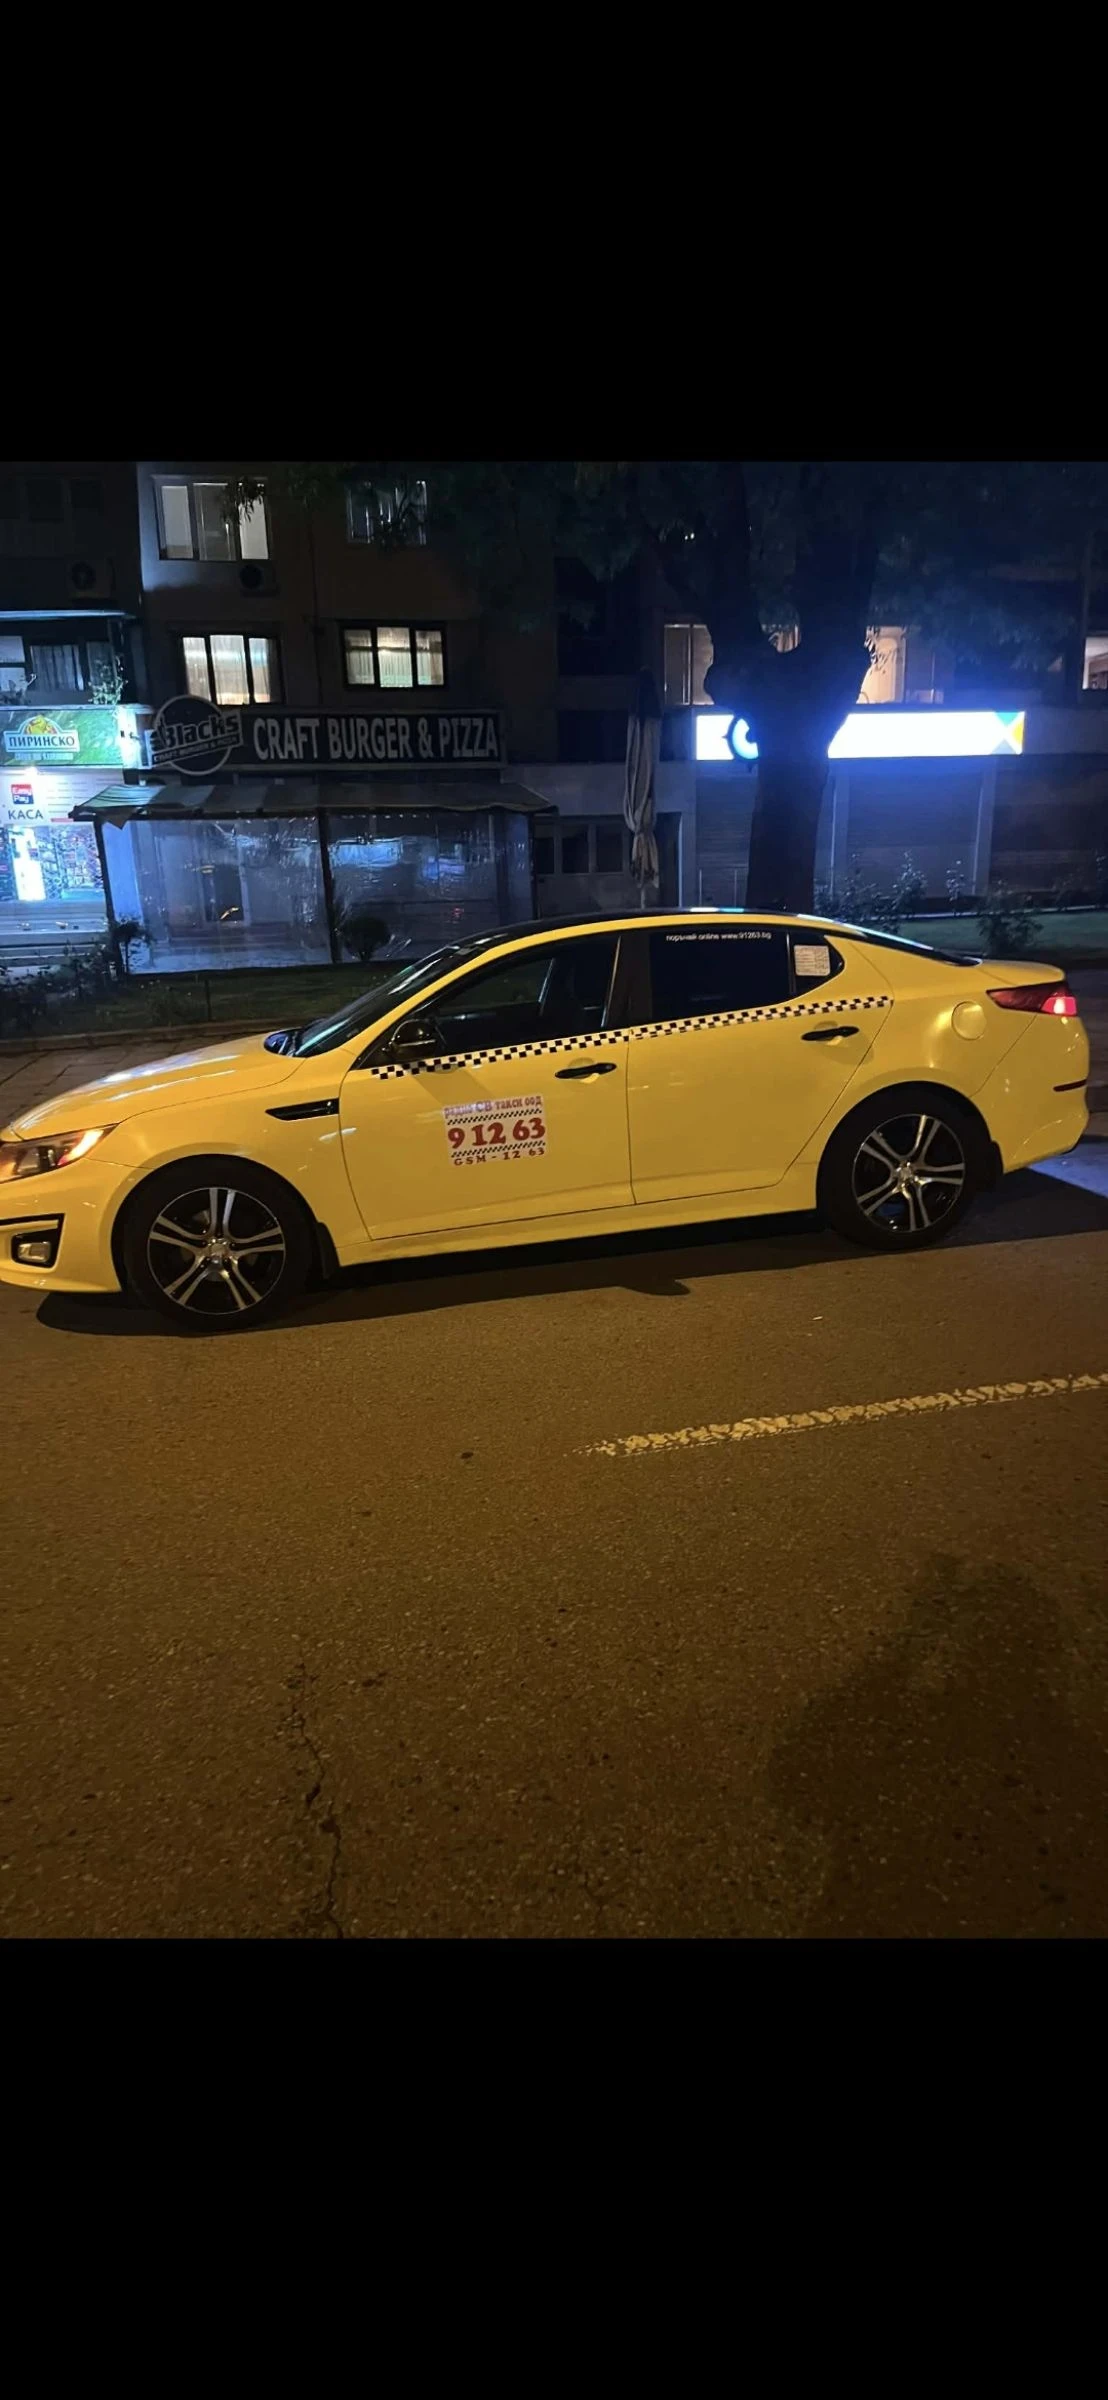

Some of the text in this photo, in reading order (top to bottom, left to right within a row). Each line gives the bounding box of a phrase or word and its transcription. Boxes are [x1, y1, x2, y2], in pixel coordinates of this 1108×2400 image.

[158, 715, 240, 748] Blacks
[253, 717, 498, 760] CRAFT BURGER & PIZZA
[9, 736, 75, 747] ПИРИНСКО
[14, 795, 30, 804] Pay
[8, 809, 44, 820] КАСА
[698, 932, 719, 940] online
[447, 1117, 546, 1149] 9 12 63
[453, 1154, 487, 1167] GSM
[503, 1150, 521, 1161] 12
[528, 1147, 545, 1157] 63
